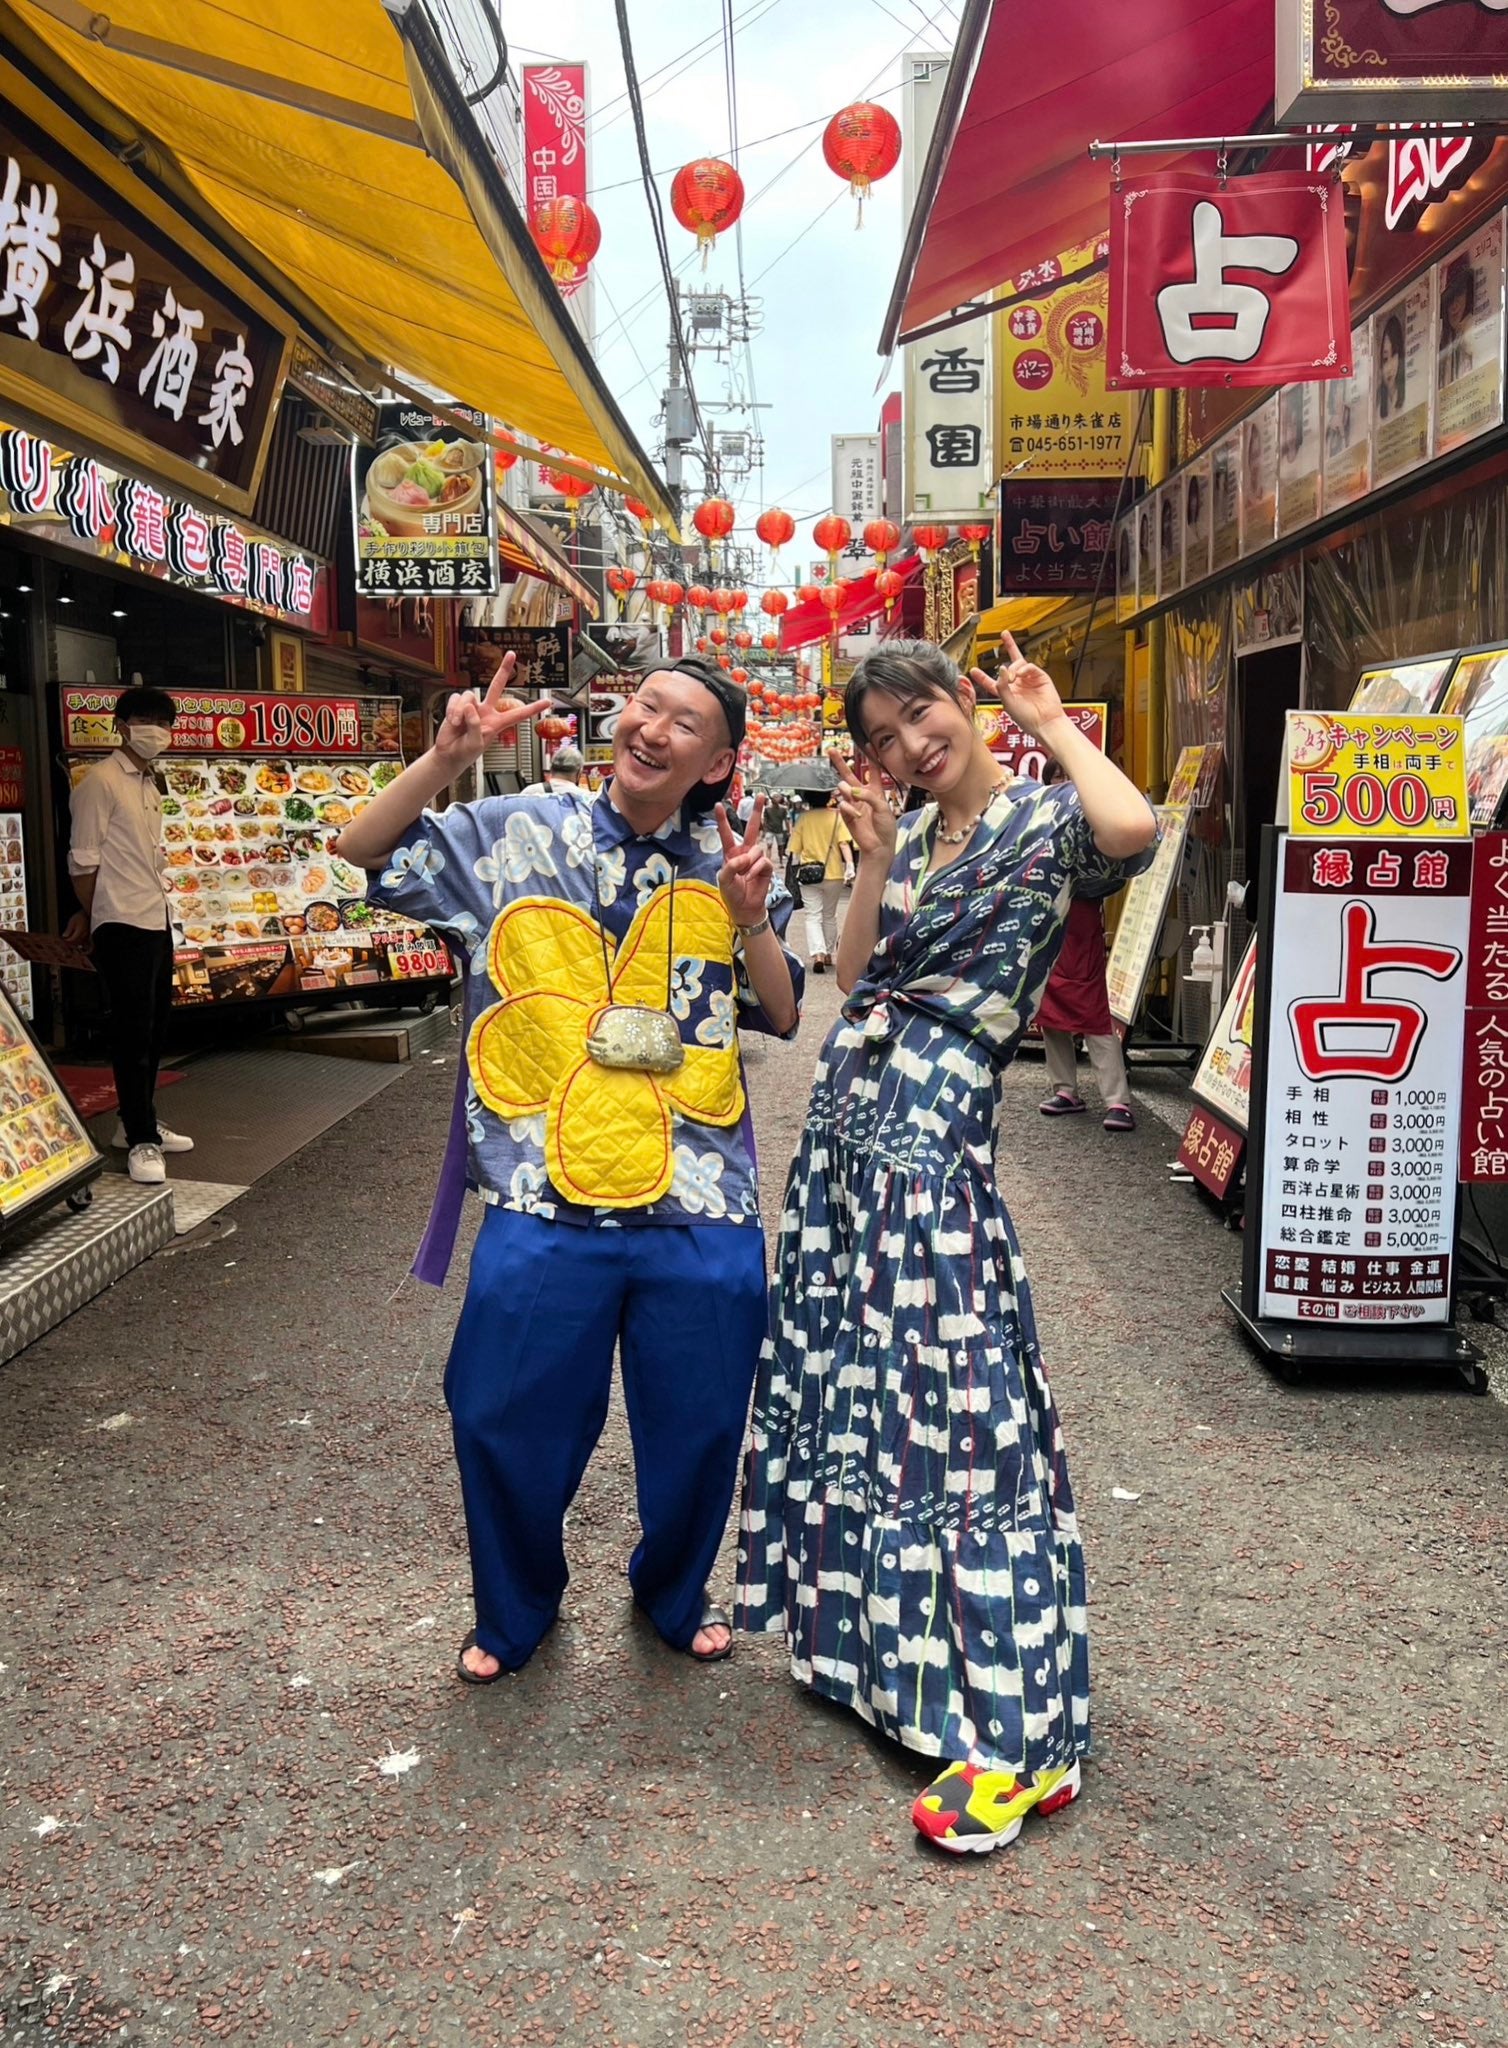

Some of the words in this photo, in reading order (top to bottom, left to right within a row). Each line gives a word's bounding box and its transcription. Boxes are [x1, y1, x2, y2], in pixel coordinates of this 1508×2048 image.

[1156, 200, 1299, 364] 占
[1016, 360, 1050, 370] パワー
[1017, 369, 1050, 379] ストーン
[921, 300, 985, 468] 香園
[1009, 411, 1122, 430] 市場通り朱雀店
[1026, 434, 1122, 453] 045-651-1977
[422, 512, 483, 534] 専門店
[363, 558, 488, 587] 横浜酒家
[250, 701, 360, 747] 1980円
[1329, 723, 1459, 750] キャンペーン
[1301, 772, 1457, 828] 500円
[1312, 848, 1450, 889] 縁占館
[1287, 899, 1463, 1083] 占
[1395, 1089, 1447, 1107] 1,000円
[1392, 1113, 1446, 1131] 3,000円
[1182, 1115, 1235, 1182] 縁占館
[1285, 1133, 1350, 1151] タロット
[1391, 1137, 1445, 1154] 3,000円
[1283, 1156, 1341, 1175] 算命学
[1390, 1160, 1443, 1178] 3,000円
[1282, 1180, 1361, 1199] 西洋占星術
[1389, 1184, 1442, 1202] 3,000円
[1281, 1203, 1353, 1223] 四柱推命
[1387, 1207, 1441, 1225] 3,000円
[1280, 1226, 1352, 1247] 総合鑑定
[1274, 1254, 1310, 1272] 恋愛
[1321, 1258, 1356, 1275] 結婚
[1367, 1260, 1401, 1276] 仕事
[1410, 1259, 1441, 1276] 金運
[1273, 1273, 1310, 1291] 健康
[1320, 1278, 1355, 1295] 悩み
[1362, 1280, 1402, 1295] ビジネス
[1406, 1279, 1444, 1295] 人間関係
[1299, 1302, 1337, 1318] その他
[1343, 1303, 1426, 1321] ご相談下さい
